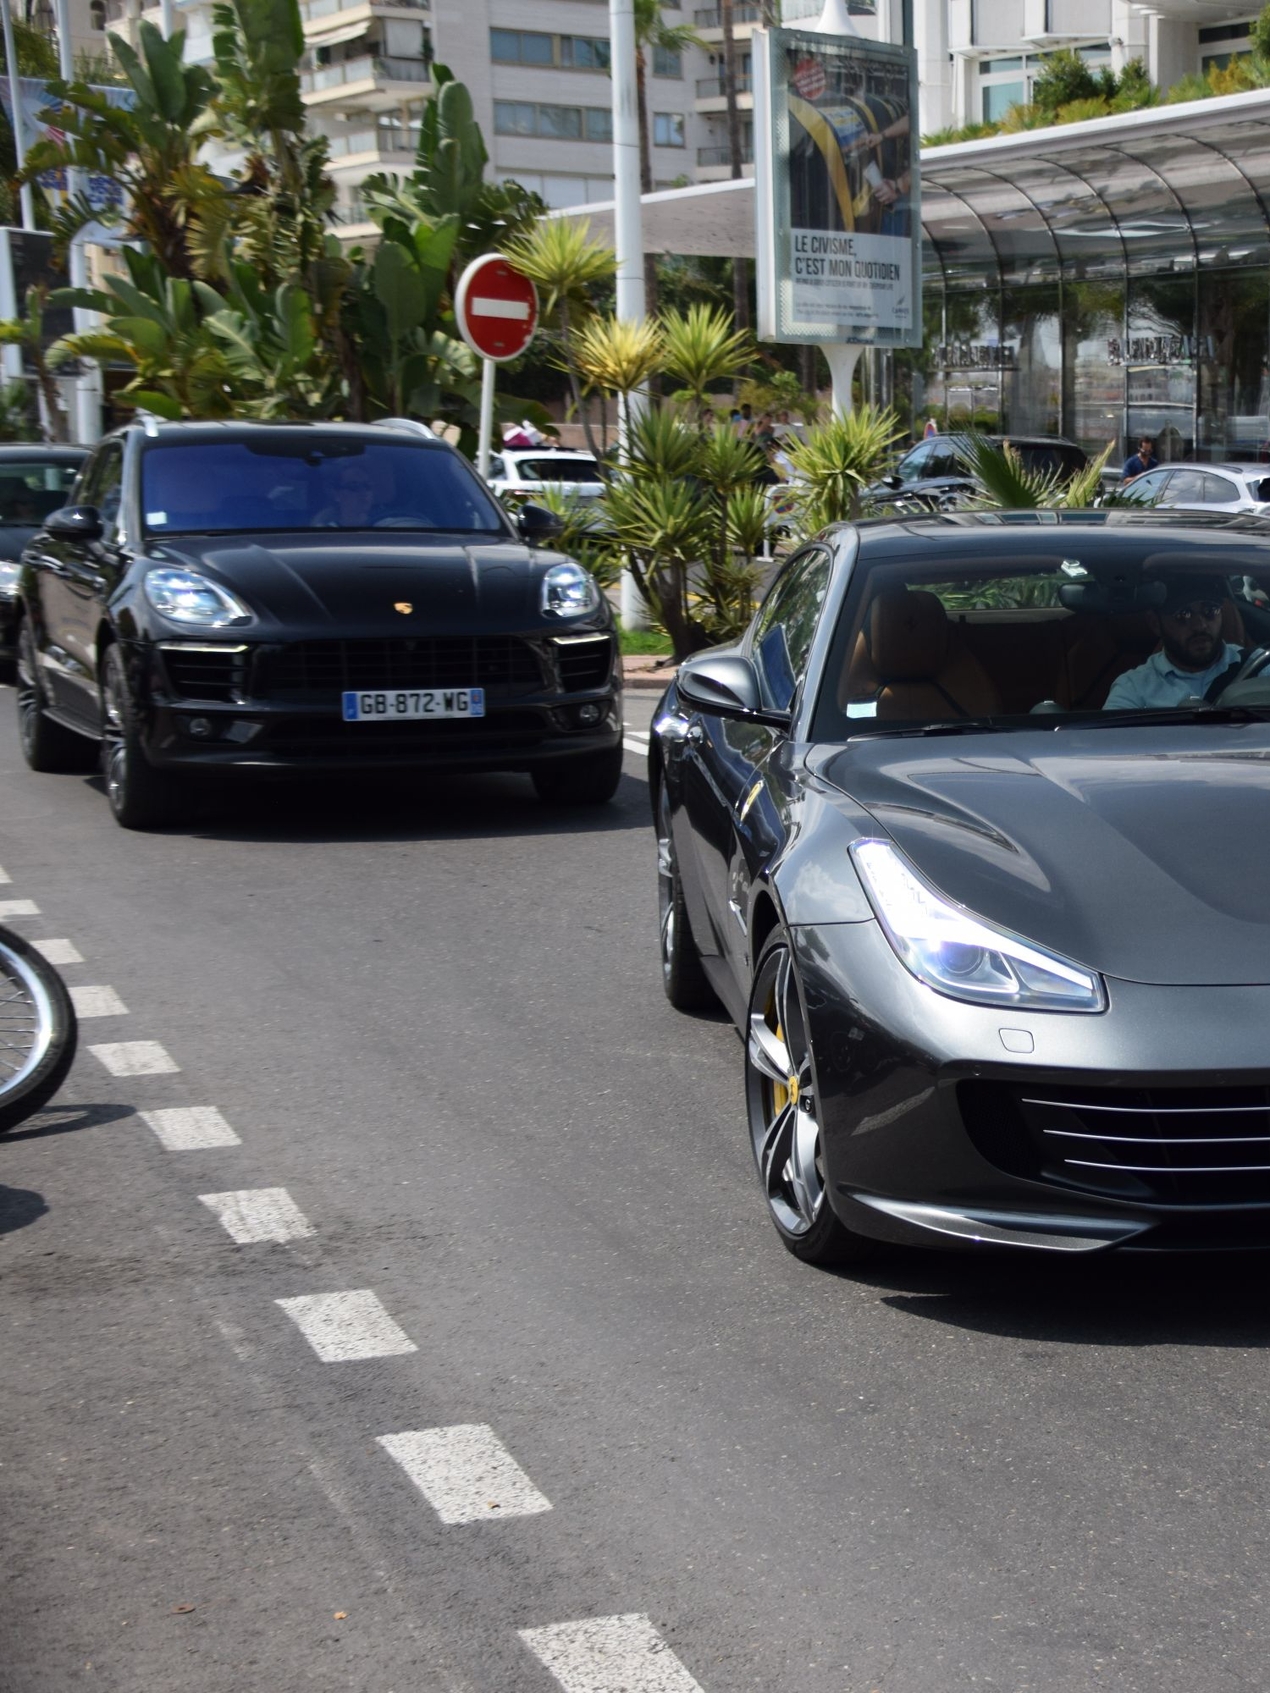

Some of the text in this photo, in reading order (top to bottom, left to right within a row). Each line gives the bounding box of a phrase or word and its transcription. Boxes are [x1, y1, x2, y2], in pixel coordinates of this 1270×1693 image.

[795, 235, 857, 257] LE CIVISME,
[795, 257, 901, 281] C'EST MON QUOTIDIEN
[360, 691, 468, 714] GB-872-WG
